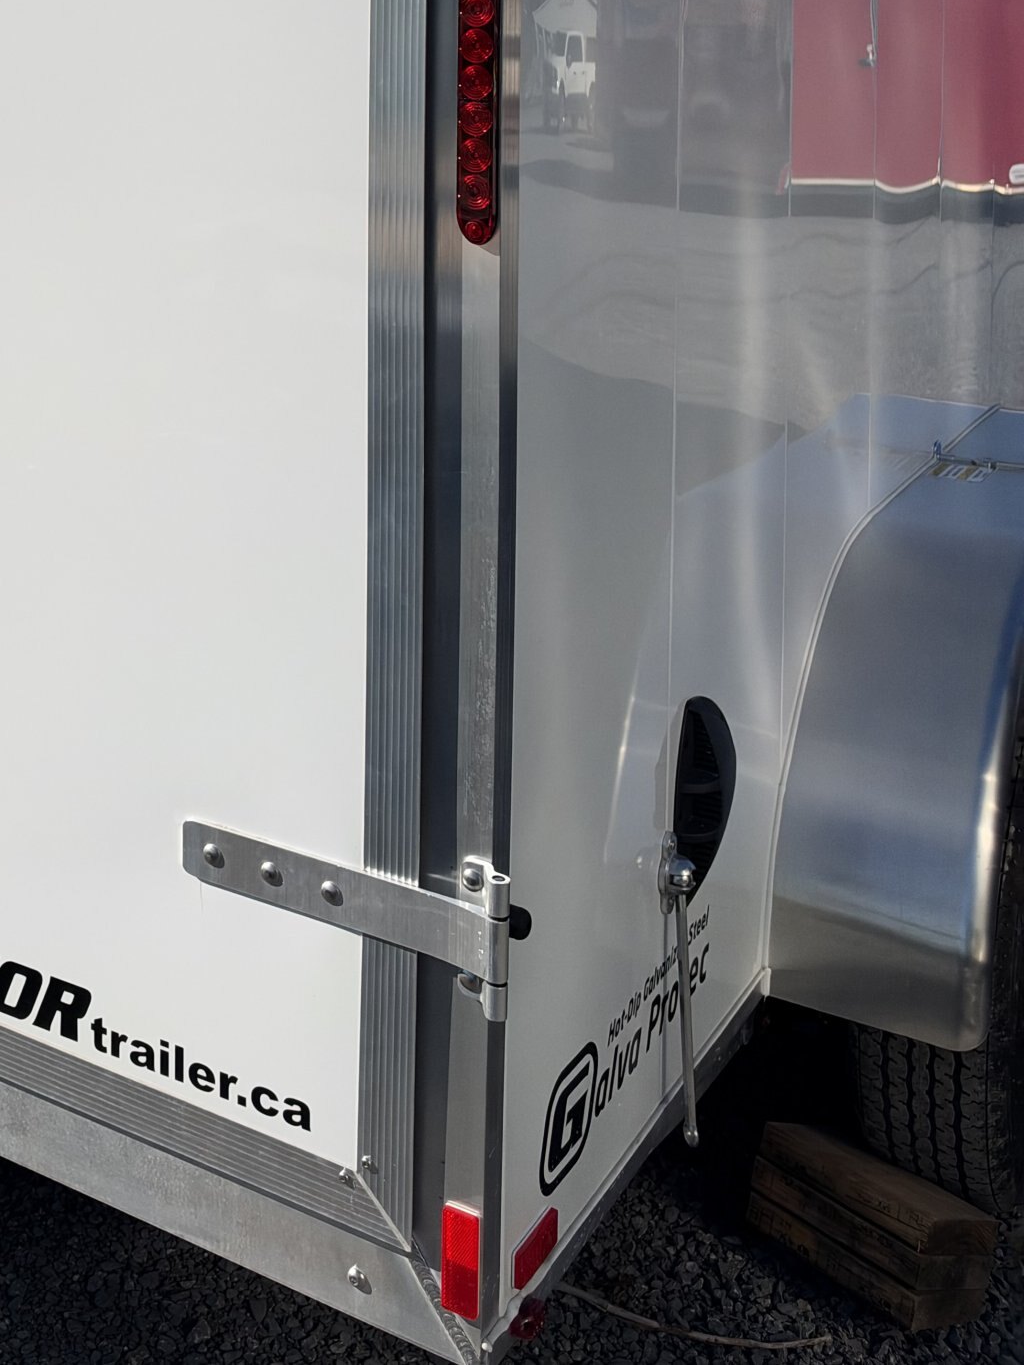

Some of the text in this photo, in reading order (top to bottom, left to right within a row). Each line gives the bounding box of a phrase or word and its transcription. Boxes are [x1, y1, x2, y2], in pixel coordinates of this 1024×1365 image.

[607, 903, 710, 1048] Hot-Dip Galvaniz Steel
[645, 941, 710, 1054] Proec
